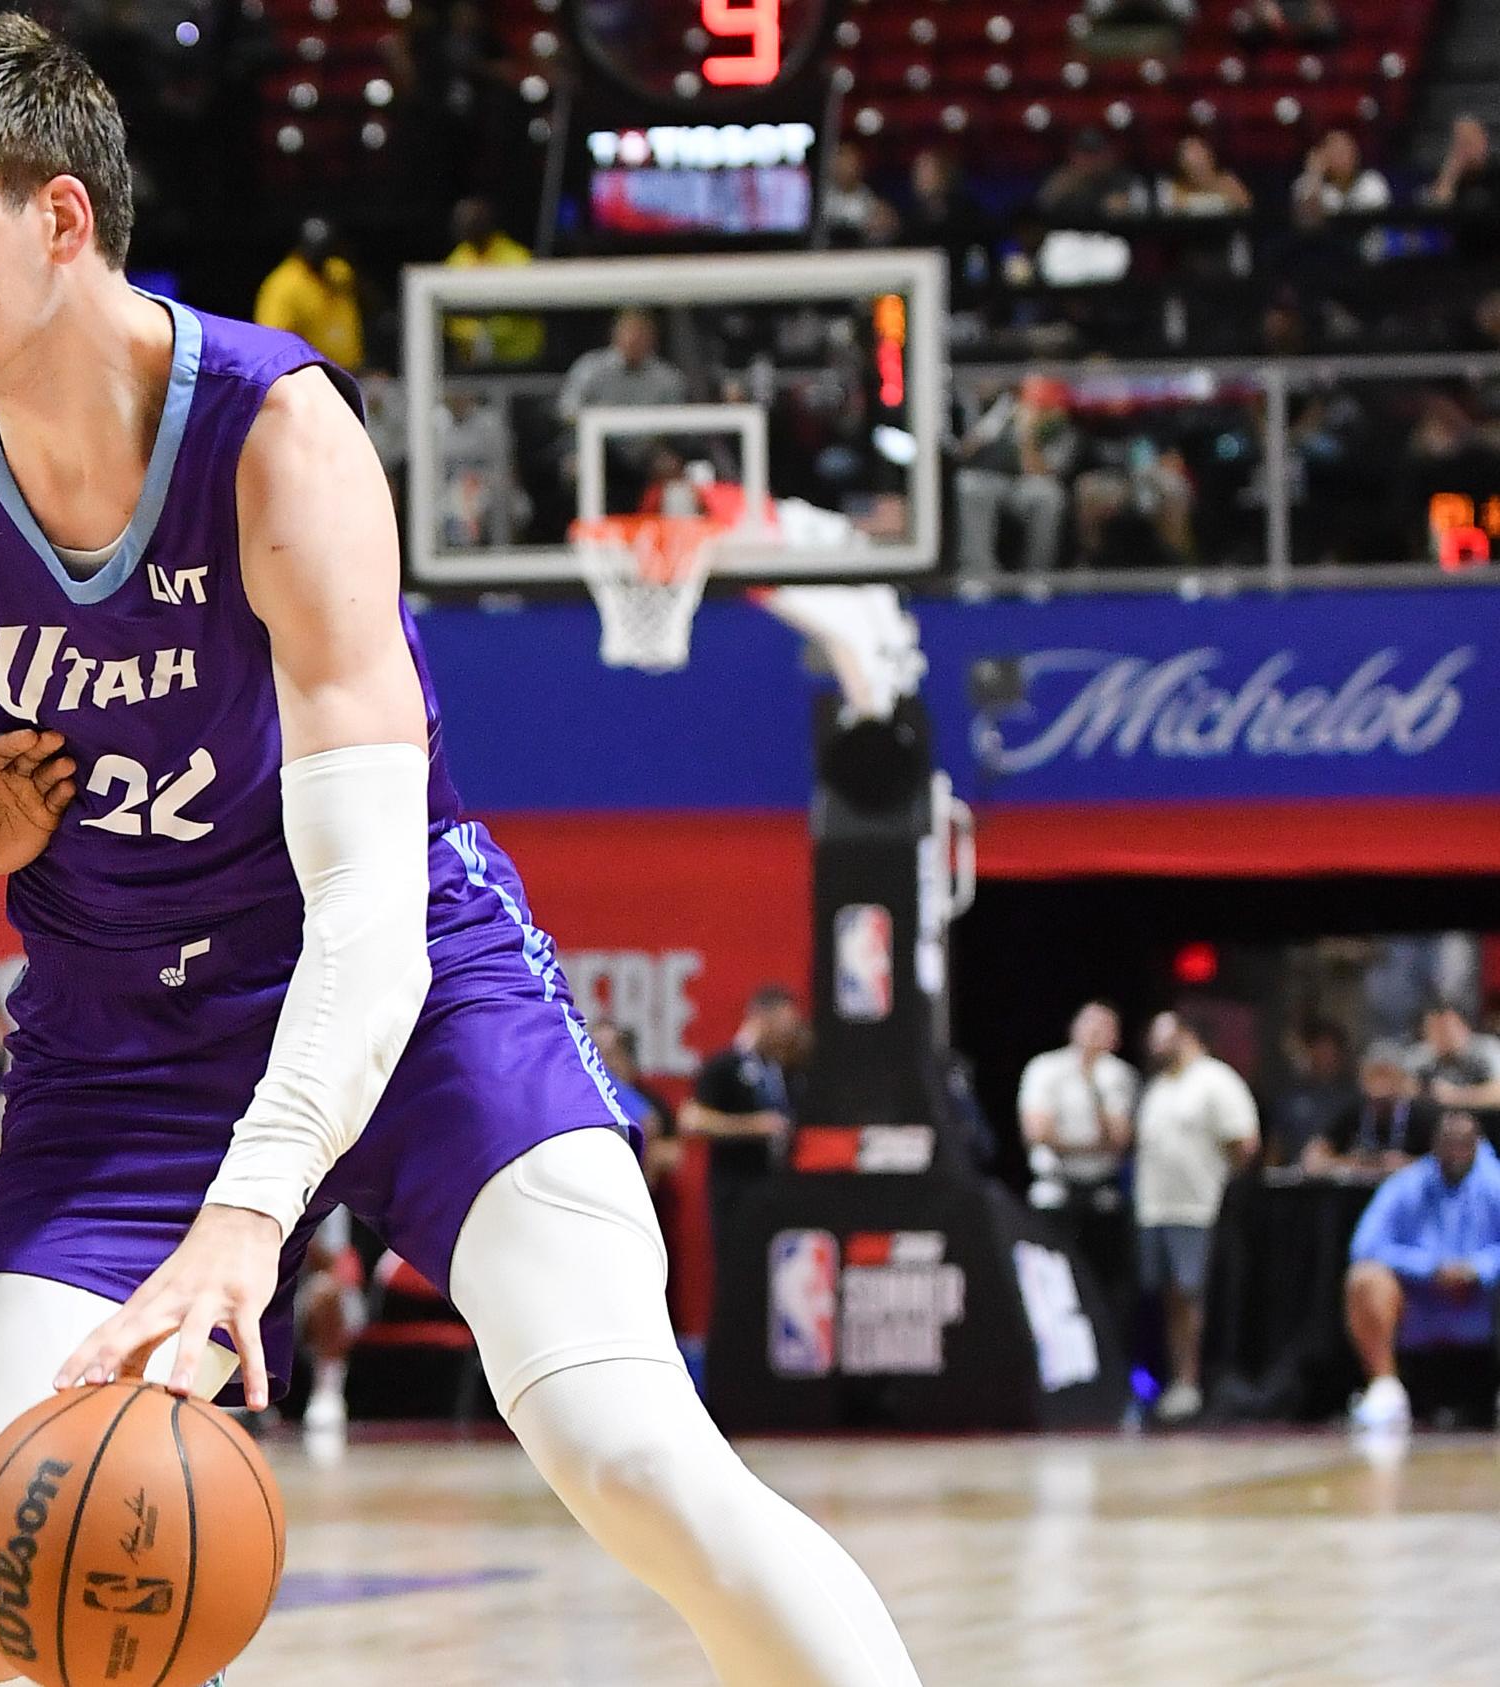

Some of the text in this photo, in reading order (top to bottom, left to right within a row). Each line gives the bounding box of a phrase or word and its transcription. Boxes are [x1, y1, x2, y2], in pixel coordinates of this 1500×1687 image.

[701, 0, 780, 86] 9
[971, 645, 1477, 774] Michelob
[80, 747, 217, 842] 22
